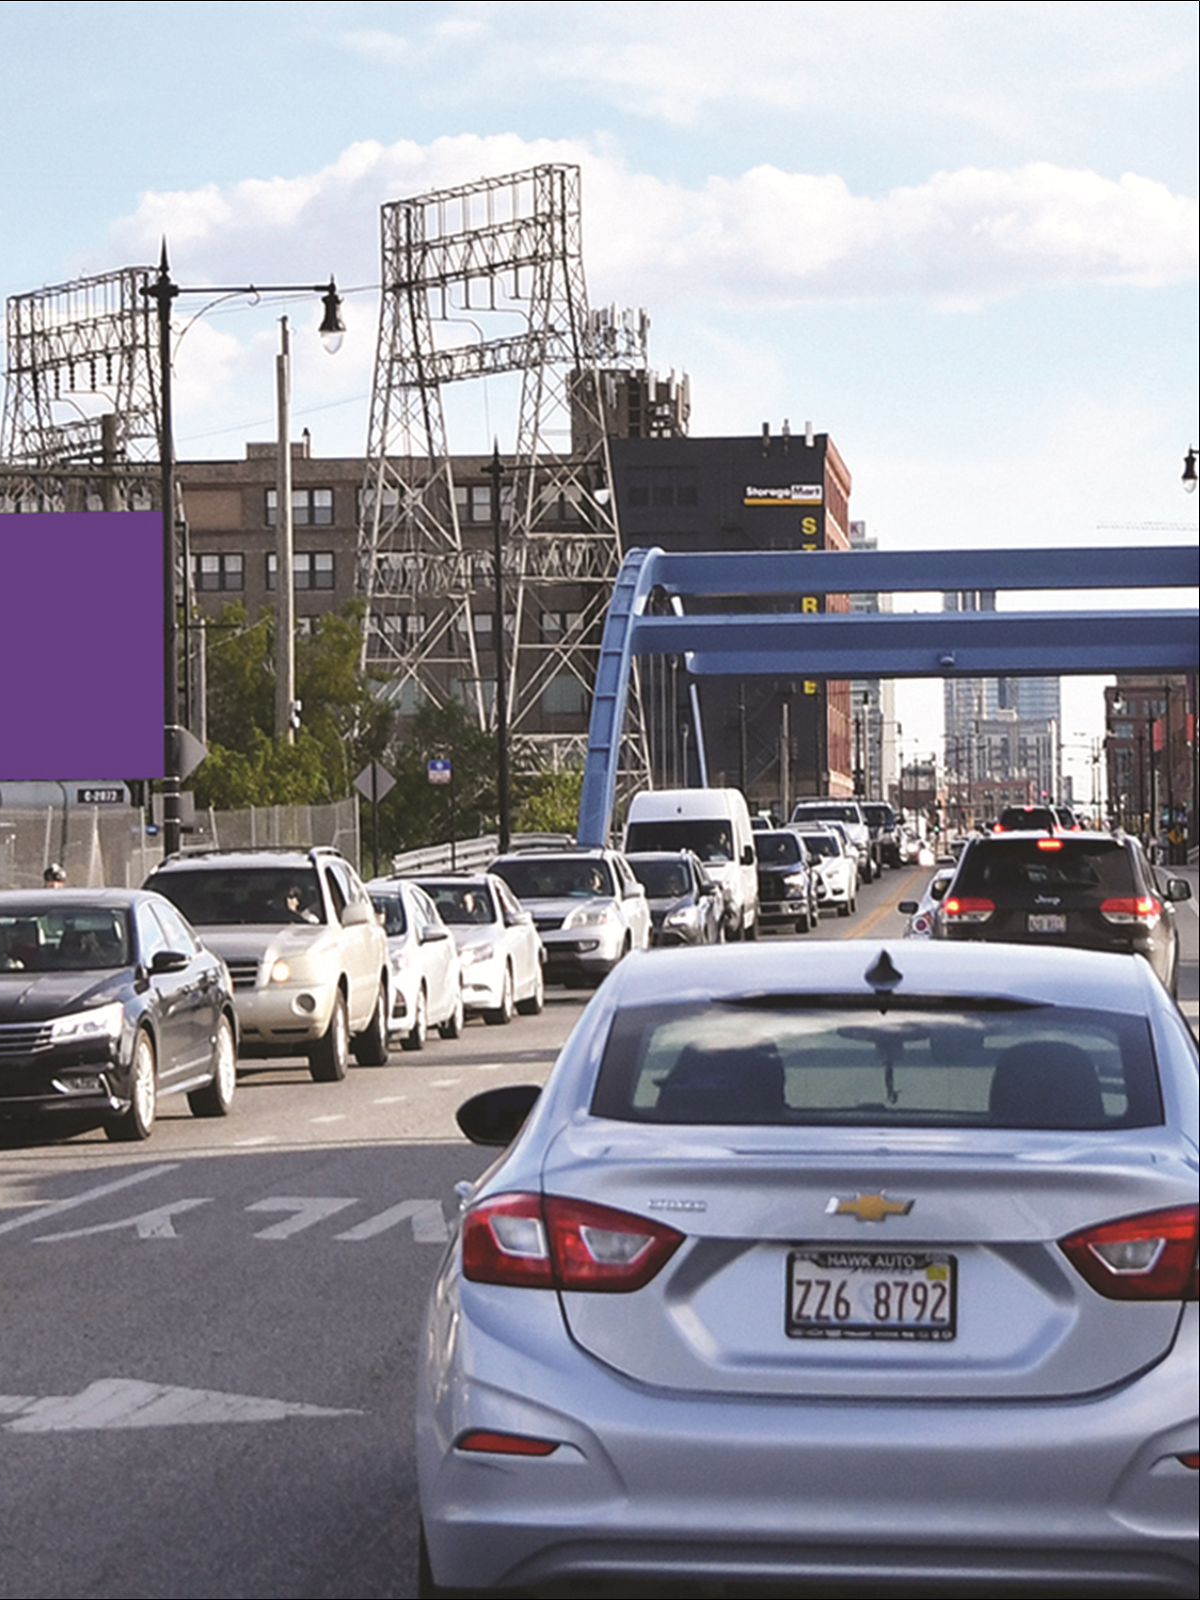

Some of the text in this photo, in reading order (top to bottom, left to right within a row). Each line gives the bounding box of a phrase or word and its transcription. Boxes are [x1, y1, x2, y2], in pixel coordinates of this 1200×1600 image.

[827, 1254, 871, 1267] HAWK
[875, 1254, 916, 1268] AUTO
[874, 1281, 947, 1322] 8792
